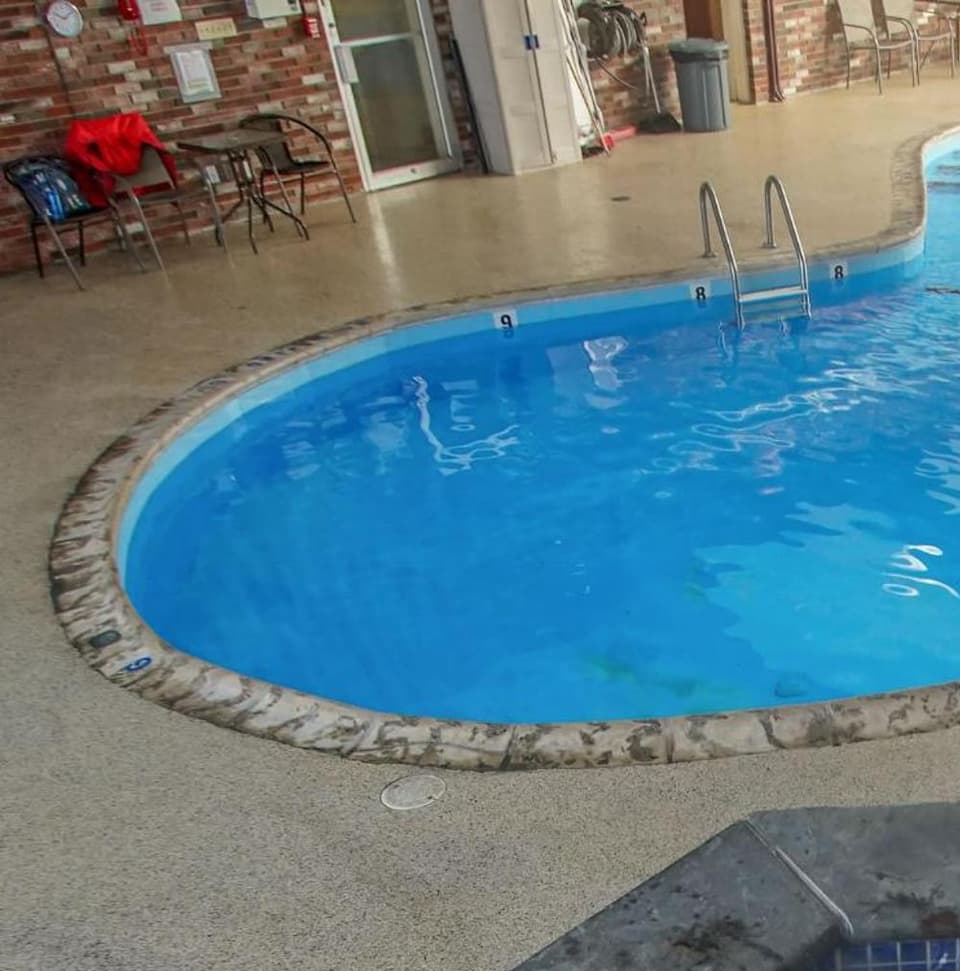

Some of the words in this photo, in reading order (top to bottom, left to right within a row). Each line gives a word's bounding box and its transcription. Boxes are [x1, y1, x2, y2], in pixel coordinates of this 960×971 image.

[834, 264, 844, 280] 8
[695, 286, 706, 302] 8
[500, 313, 514, 329] 9
